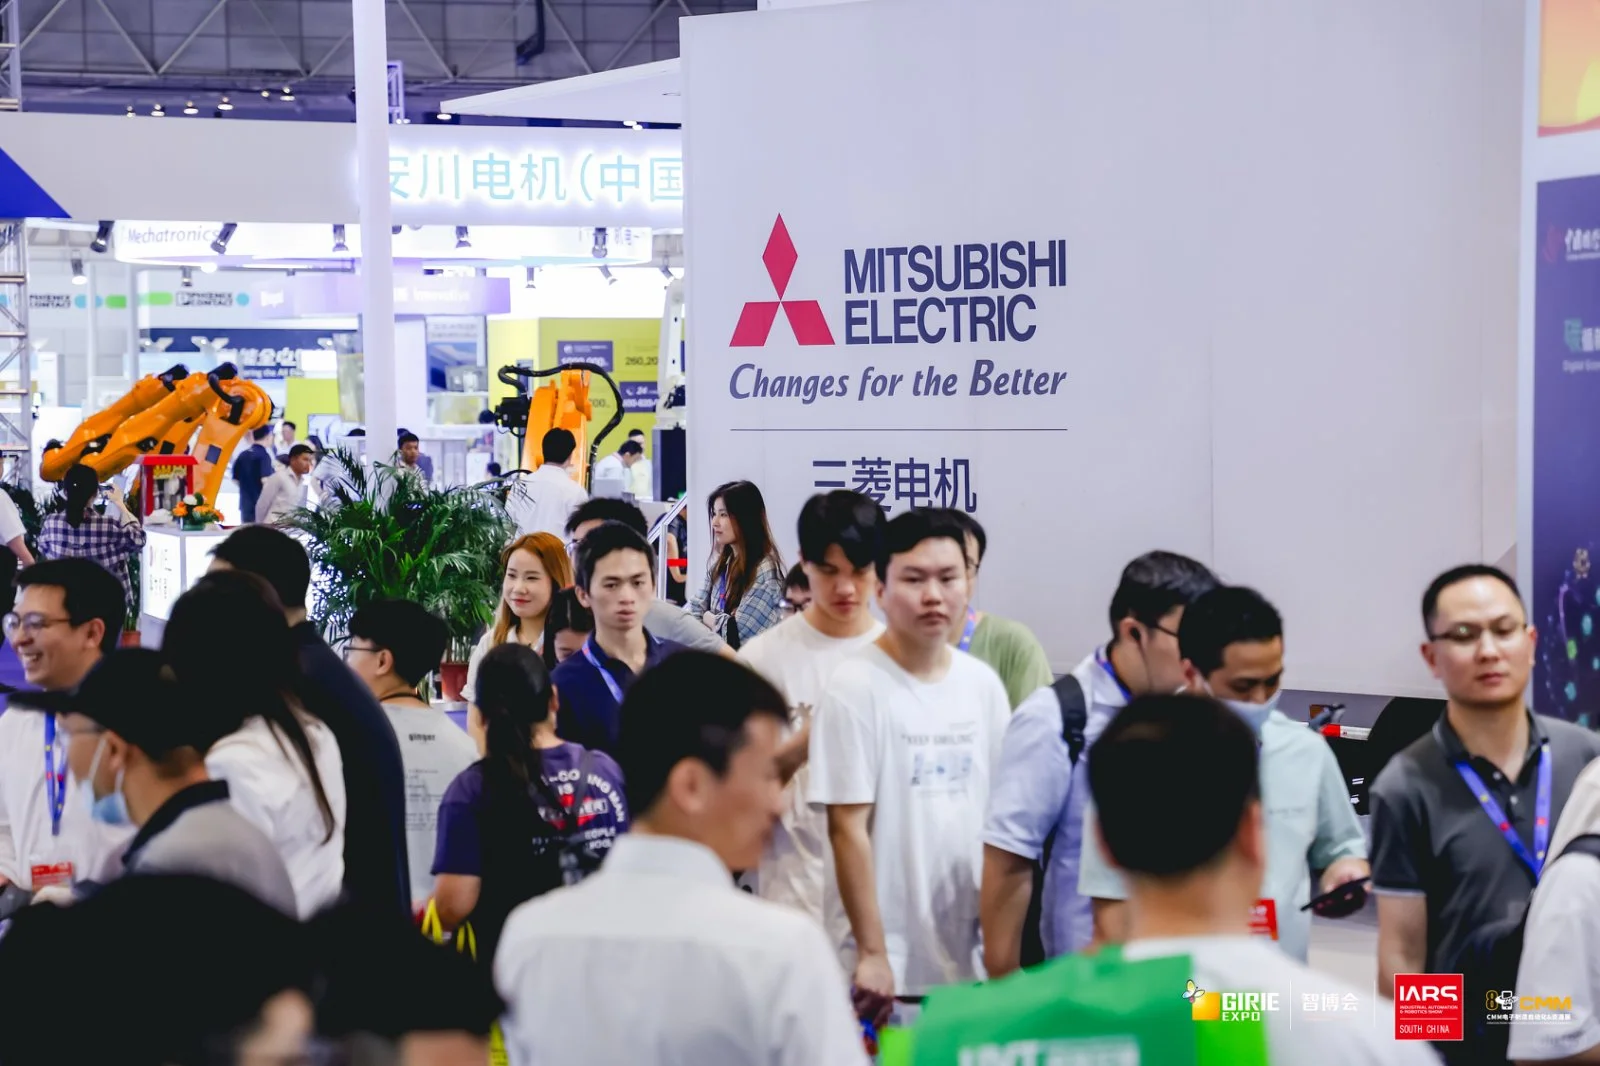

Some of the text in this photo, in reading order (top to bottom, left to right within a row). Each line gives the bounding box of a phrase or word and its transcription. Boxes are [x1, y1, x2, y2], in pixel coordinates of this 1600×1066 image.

[844, 239, 1067, 295] MITSUBISHI
[845, 293, 1037, 346] ELECTRIC
[729, 359, 1067, 405] Changes for the Better
[812, 457, 977, 513] 三菱电机
